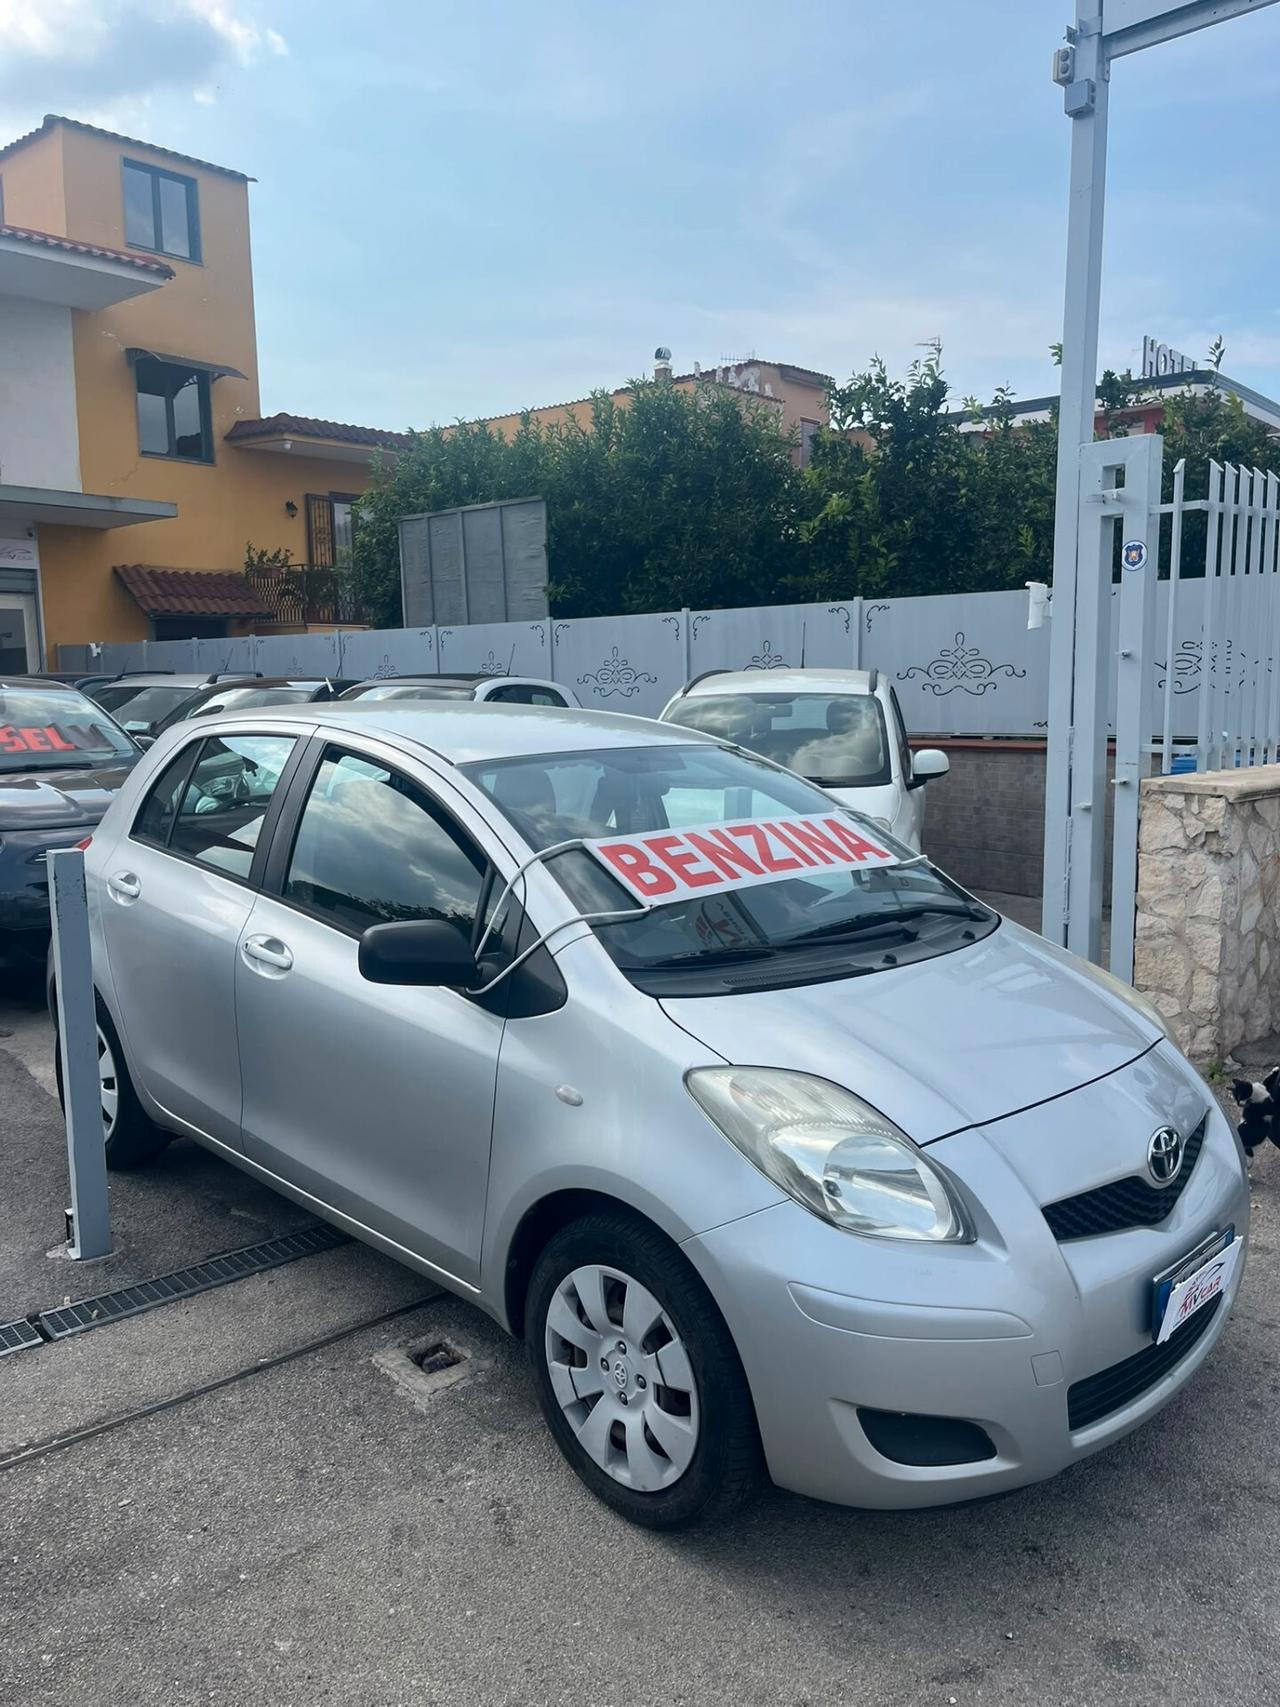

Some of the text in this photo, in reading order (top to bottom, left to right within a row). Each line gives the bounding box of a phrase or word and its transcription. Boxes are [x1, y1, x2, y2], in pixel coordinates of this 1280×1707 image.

[1142, 335, 1198, 377] HOT
[0, 725, 75, 751] SEL
[597, 818, 891, 897] BENZINA
